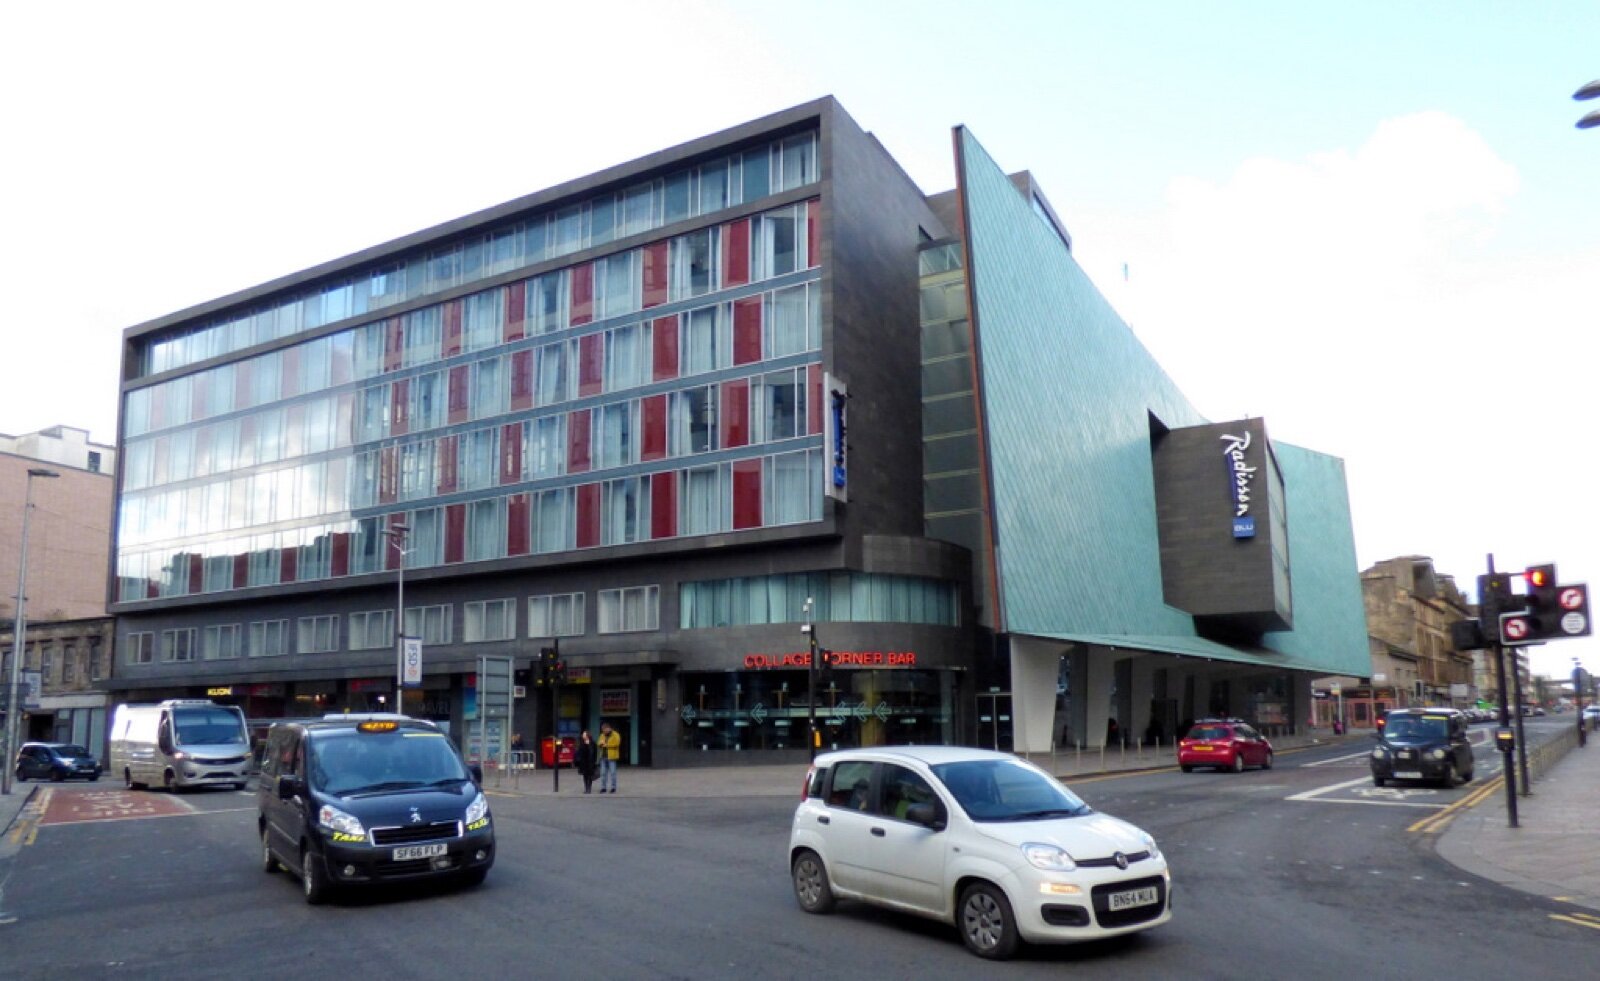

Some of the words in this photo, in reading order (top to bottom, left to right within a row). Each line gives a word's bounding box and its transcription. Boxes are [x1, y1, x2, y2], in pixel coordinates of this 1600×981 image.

[1220, 431, 1257, 516] Radisson
[744, 653, 811, 668] COLLAGE
[831, 651, 883, 665] ORNER
[888, 652, 917, 665] BAR
